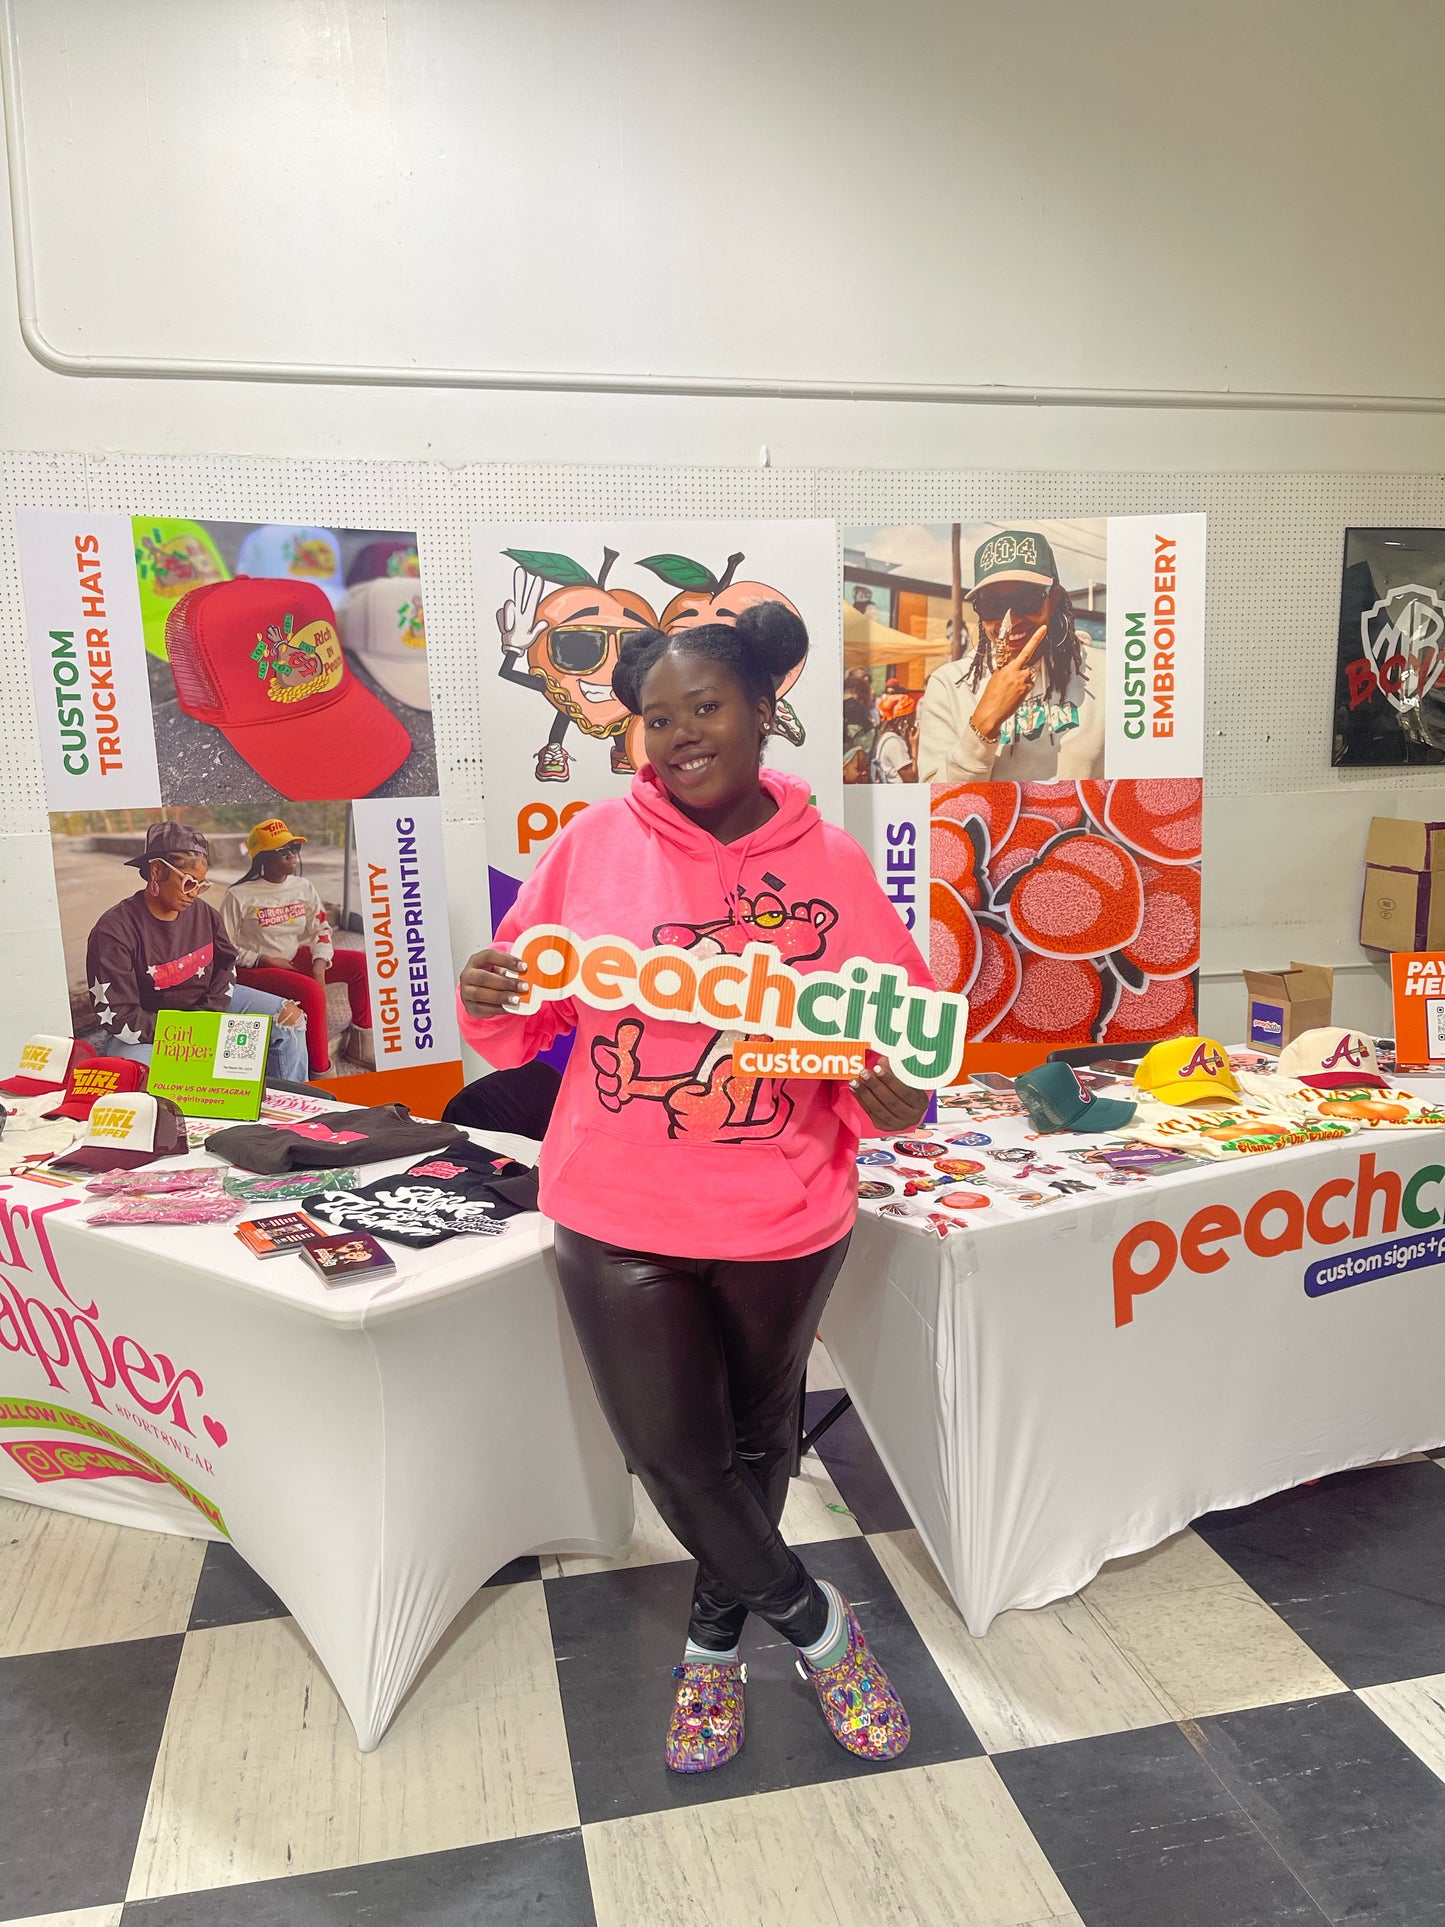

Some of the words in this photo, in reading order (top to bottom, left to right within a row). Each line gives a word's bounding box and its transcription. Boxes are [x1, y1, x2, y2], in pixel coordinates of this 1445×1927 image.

[75, 534, 107, 617] HATS
[980, 537, 1037, 571] 404
[1152, 534, 1176, 738] EMBROIDERY
[1123, 612, 1147, 739] CUSTOM
[49, 631, 89, 775] CUSTOM
[86, 628, 123, 775] TRUCKER
[368, 863, 399, 979] QUALITY
[396, 817, 433, 1050] SCREENPRINTING
[520, 934, 958, 1079] peachcity
[1405, 977, 1445, 996] HE
[164, 1025, 193, 1044] Girl
[379, 987, 402, 1053] HIGH
[73, 1068, 120, 1090] GIRL
[739, 1047, 865, 1076] customs
[153, 1083, 184, 1091] FOLLOW
[208, 1087, 251, 1097] INSTAGRAM
[176, 1095, 225, 1105] @girltrapperz
[92, 1107, 136, 1129] GIRL
[1112, 1152, 1445, 1329] peachc
[1316, 1254, 1382, 1286] custom
[60, 1411, 86, 1430] US
